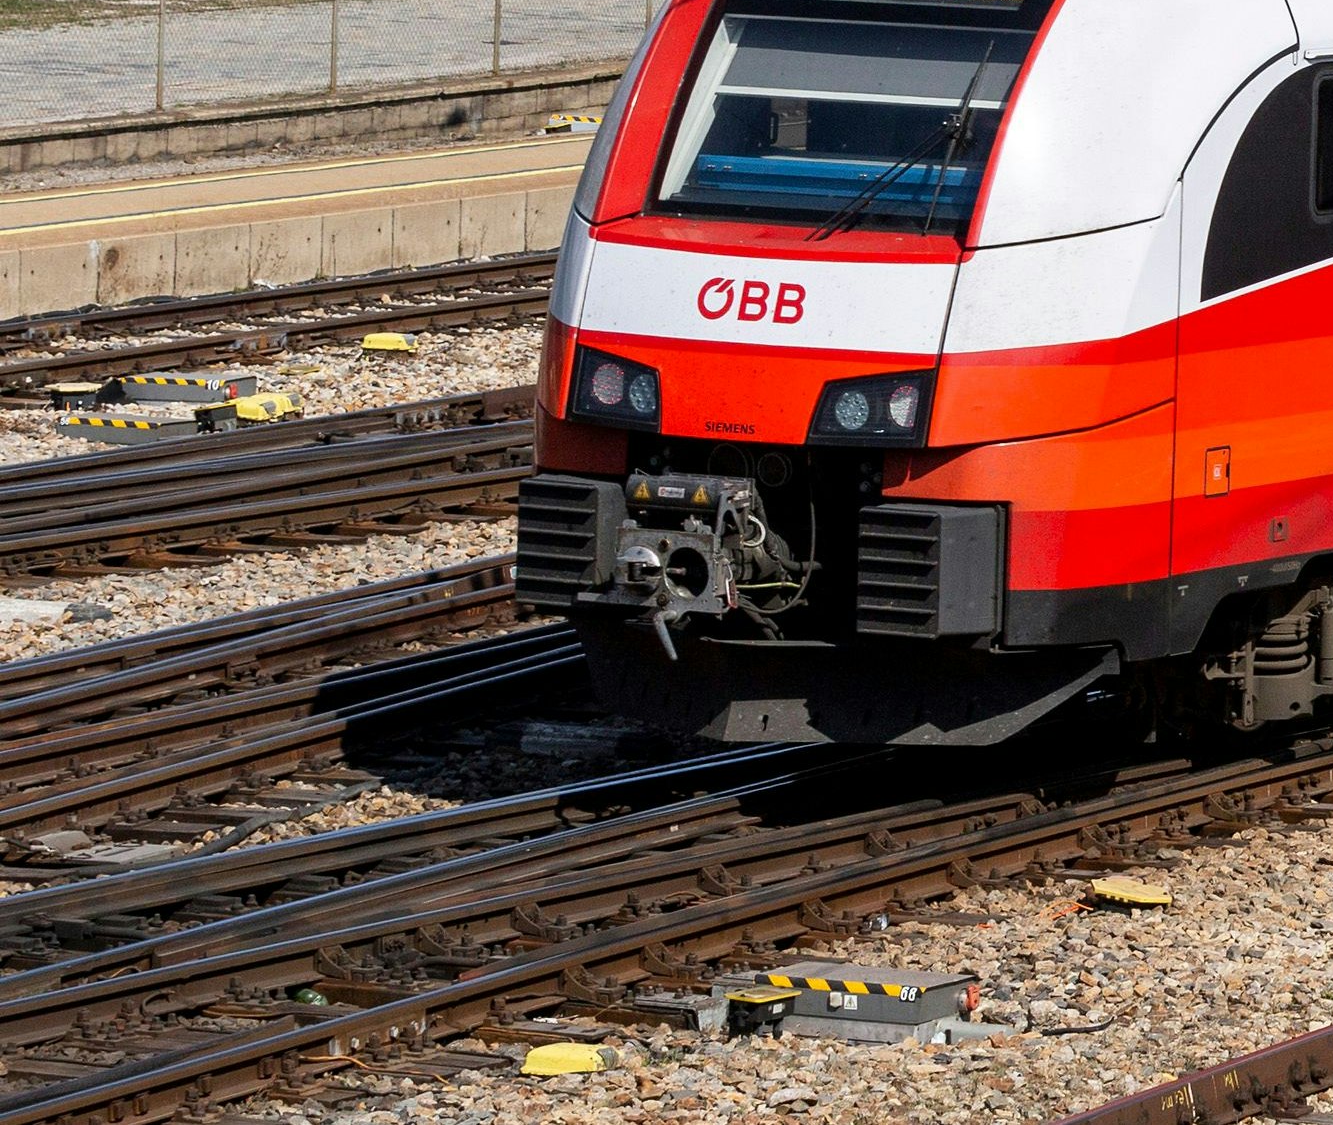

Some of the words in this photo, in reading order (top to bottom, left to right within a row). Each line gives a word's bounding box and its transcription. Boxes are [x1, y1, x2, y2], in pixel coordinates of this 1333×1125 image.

[697, 277, 806, 325] ÖBB
[206, 379, 220, 391] 10
[704, 421, 756, 435] SIEMENS
[899, 986, 918, 1002] 68
